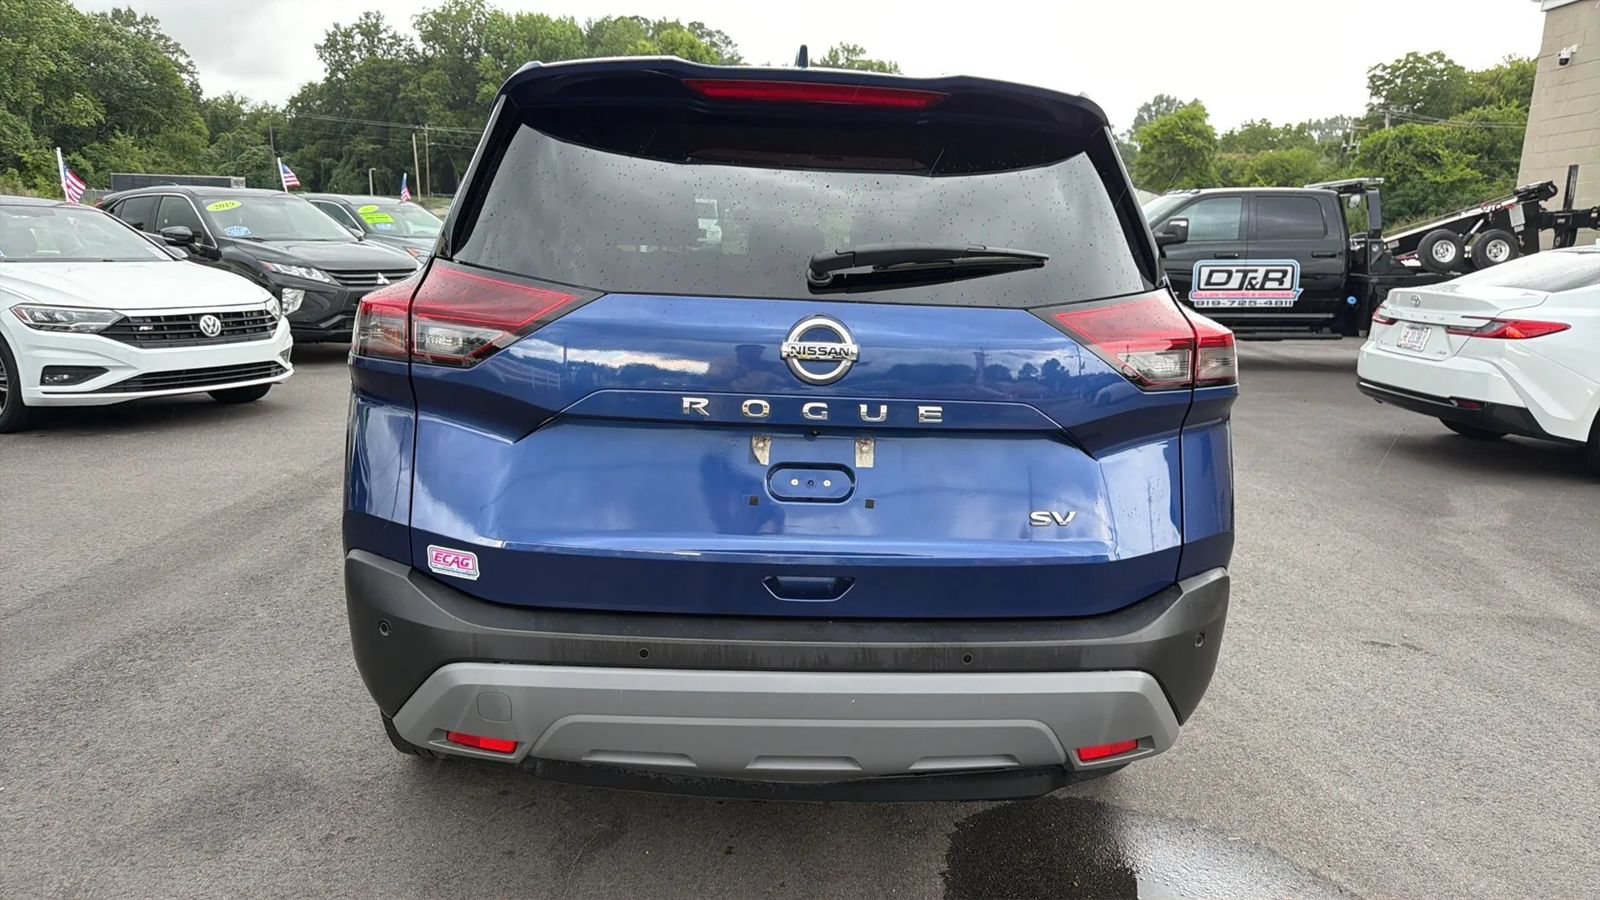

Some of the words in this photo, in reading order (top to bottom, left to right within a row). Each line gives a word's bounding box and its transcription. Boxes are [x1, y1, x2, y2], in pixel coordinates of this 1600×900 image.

[215, 201, 235, 210] 2019
[1203, 268, 1289, 291] DT&R
[790, 345, 850, 357] NISSAN
[682, 397, 943, 423] ROGUE
[1029, 511, 1077, 526] SV
[434, 552, 471, 568] ECAG
